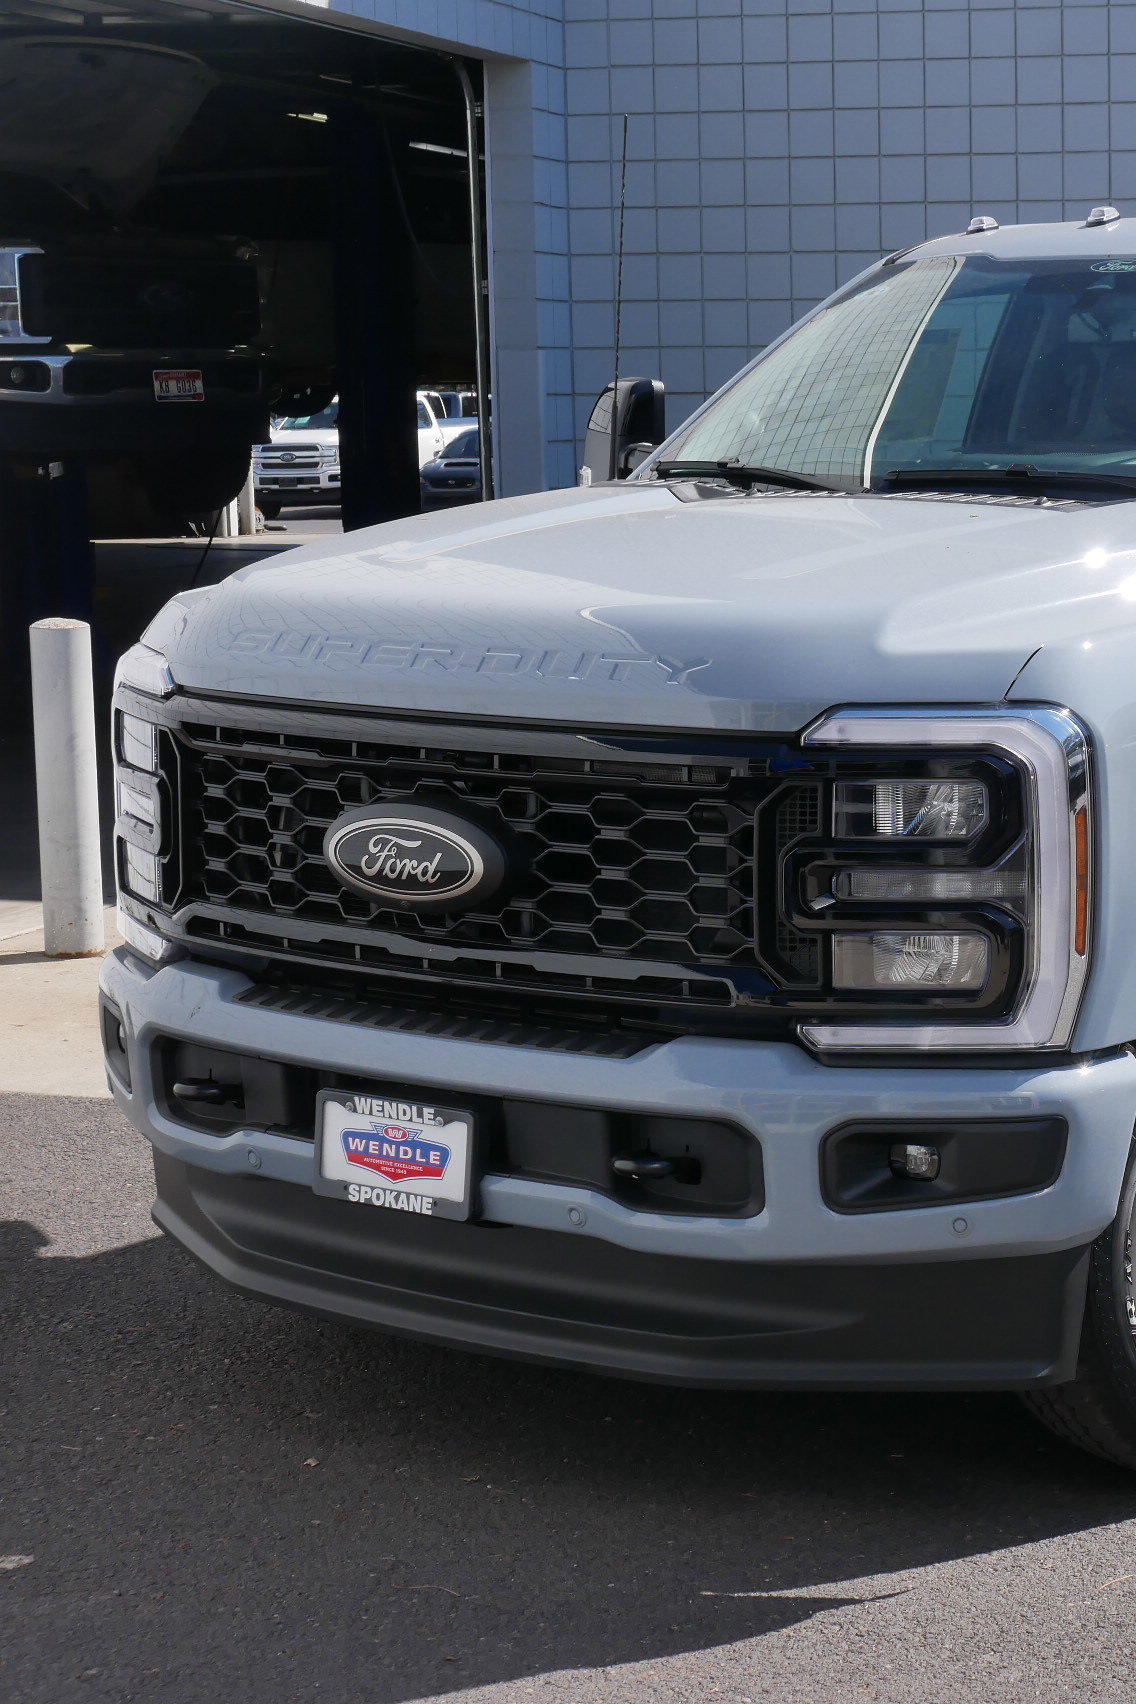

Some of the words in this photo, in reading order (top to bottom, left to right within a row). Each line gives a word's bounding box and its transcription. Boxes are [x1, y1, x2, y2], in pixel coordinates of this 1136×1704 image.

[229, 629, 456, 673] SUPER
[476, 646, 714, 686] DUTY
[361, 834, 443, 884] Ford
[353, 1096, 435, 1126] WENDLE
[348, 1136, 442, 1165] WENDLE
[363, 1157, 394, 1167] AUTOMOTIVE
[394, 1162, 423, 1172] EXCELLENCE
[348, 1184, 433, 1215] SPOKANE
